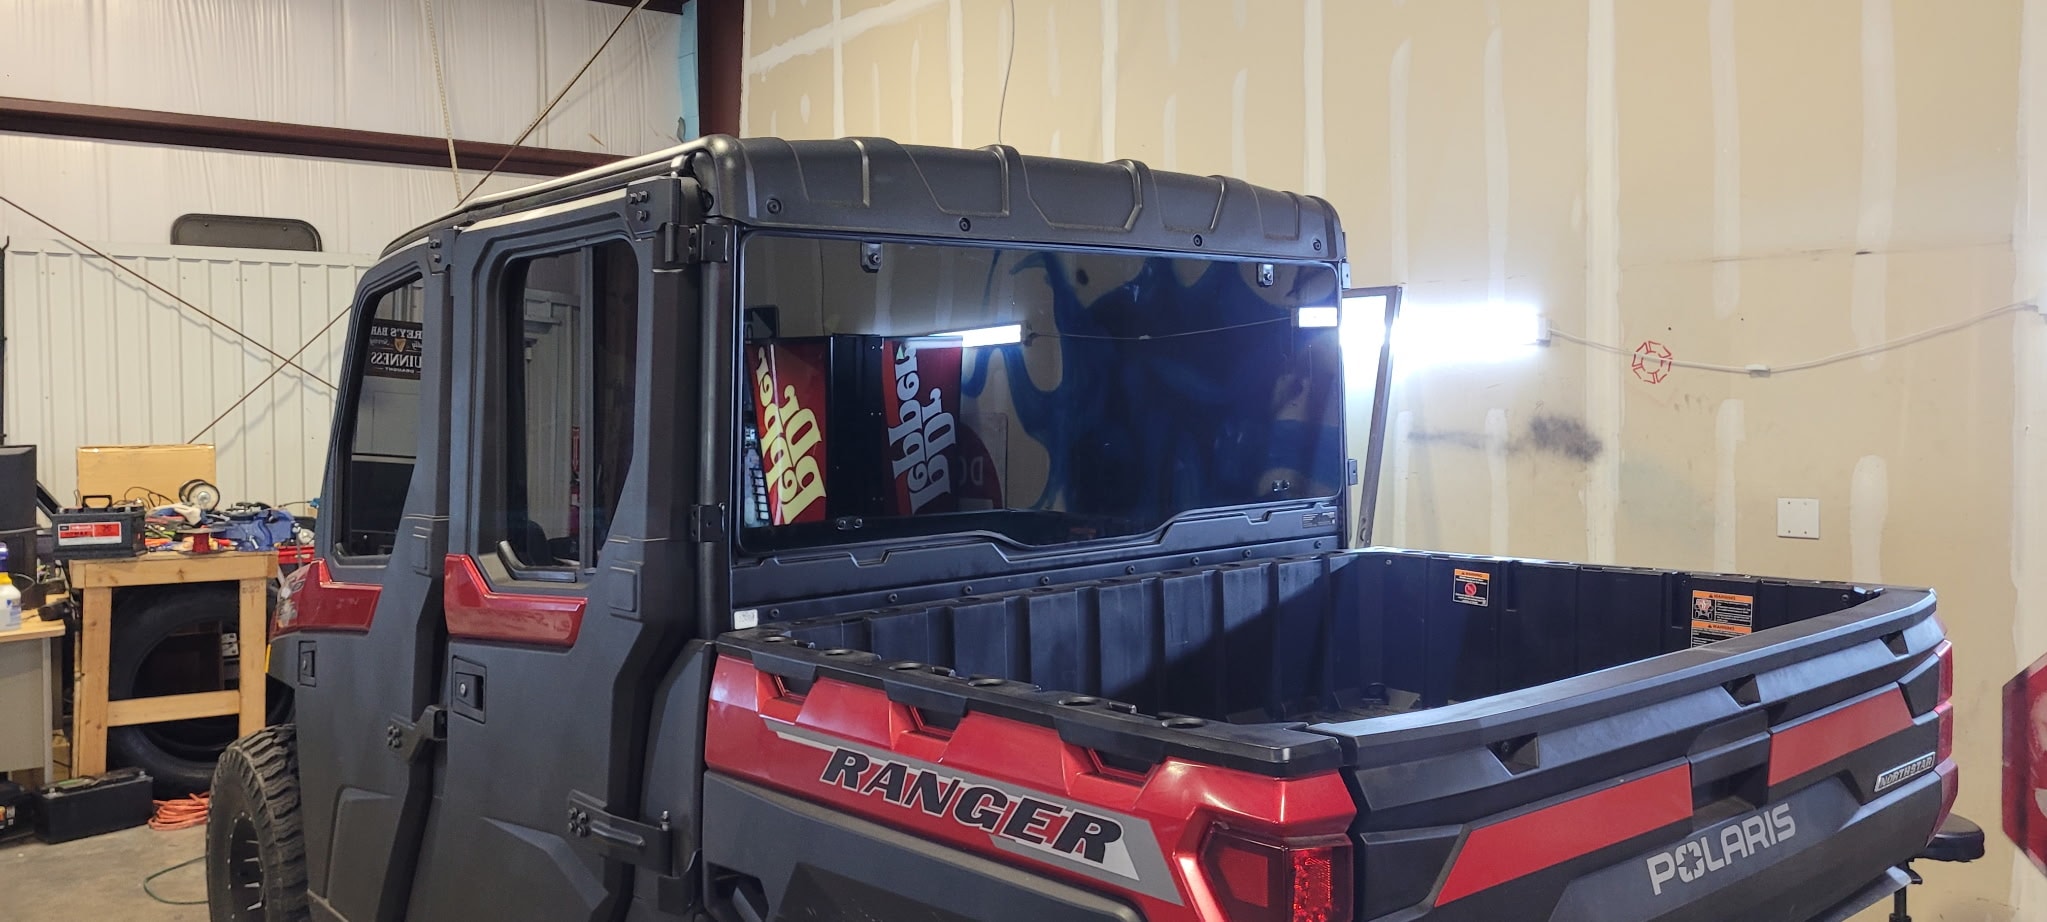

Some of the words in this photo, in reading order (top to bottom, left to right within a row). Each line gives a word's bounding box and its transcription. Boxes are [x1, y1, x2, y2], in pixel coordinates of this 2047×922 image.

[820, 747, 1123, 865] RANGER
[1879, 757, 1933, 787] NORTHSTAR
[1646, 802, 1796, 896] POLARIS
